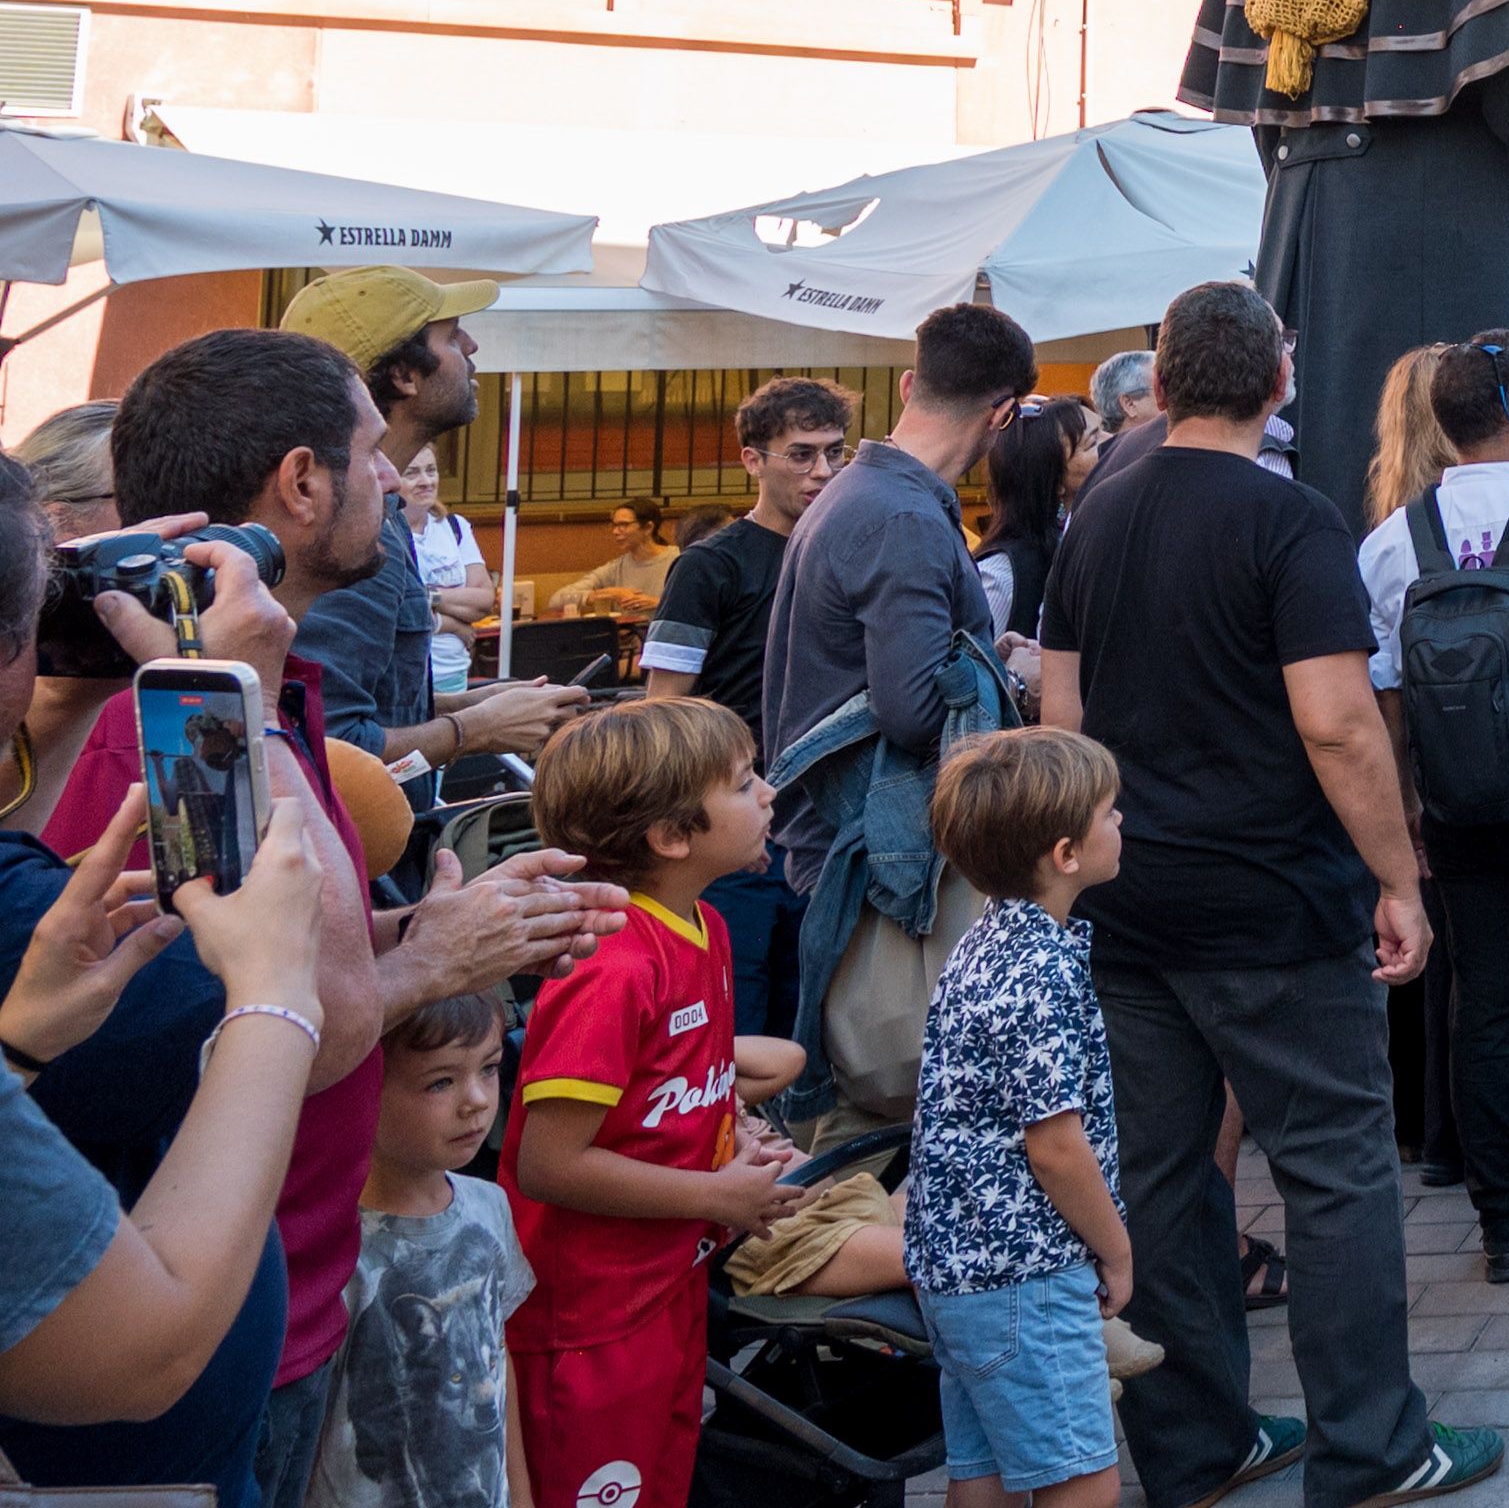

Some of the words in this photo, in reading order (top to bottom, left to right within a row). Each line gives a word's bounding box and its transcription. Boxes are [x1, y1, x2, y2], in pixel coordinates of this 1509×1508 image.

[339, 226, 406, 247] ESTRELLA
[410, 228, 452, 249] DAMM
[797, 287, 852, 310] ESTRELLA
[846, 296, 885, 315] DAMM
[674, 1006, 704, 1030] 0004
